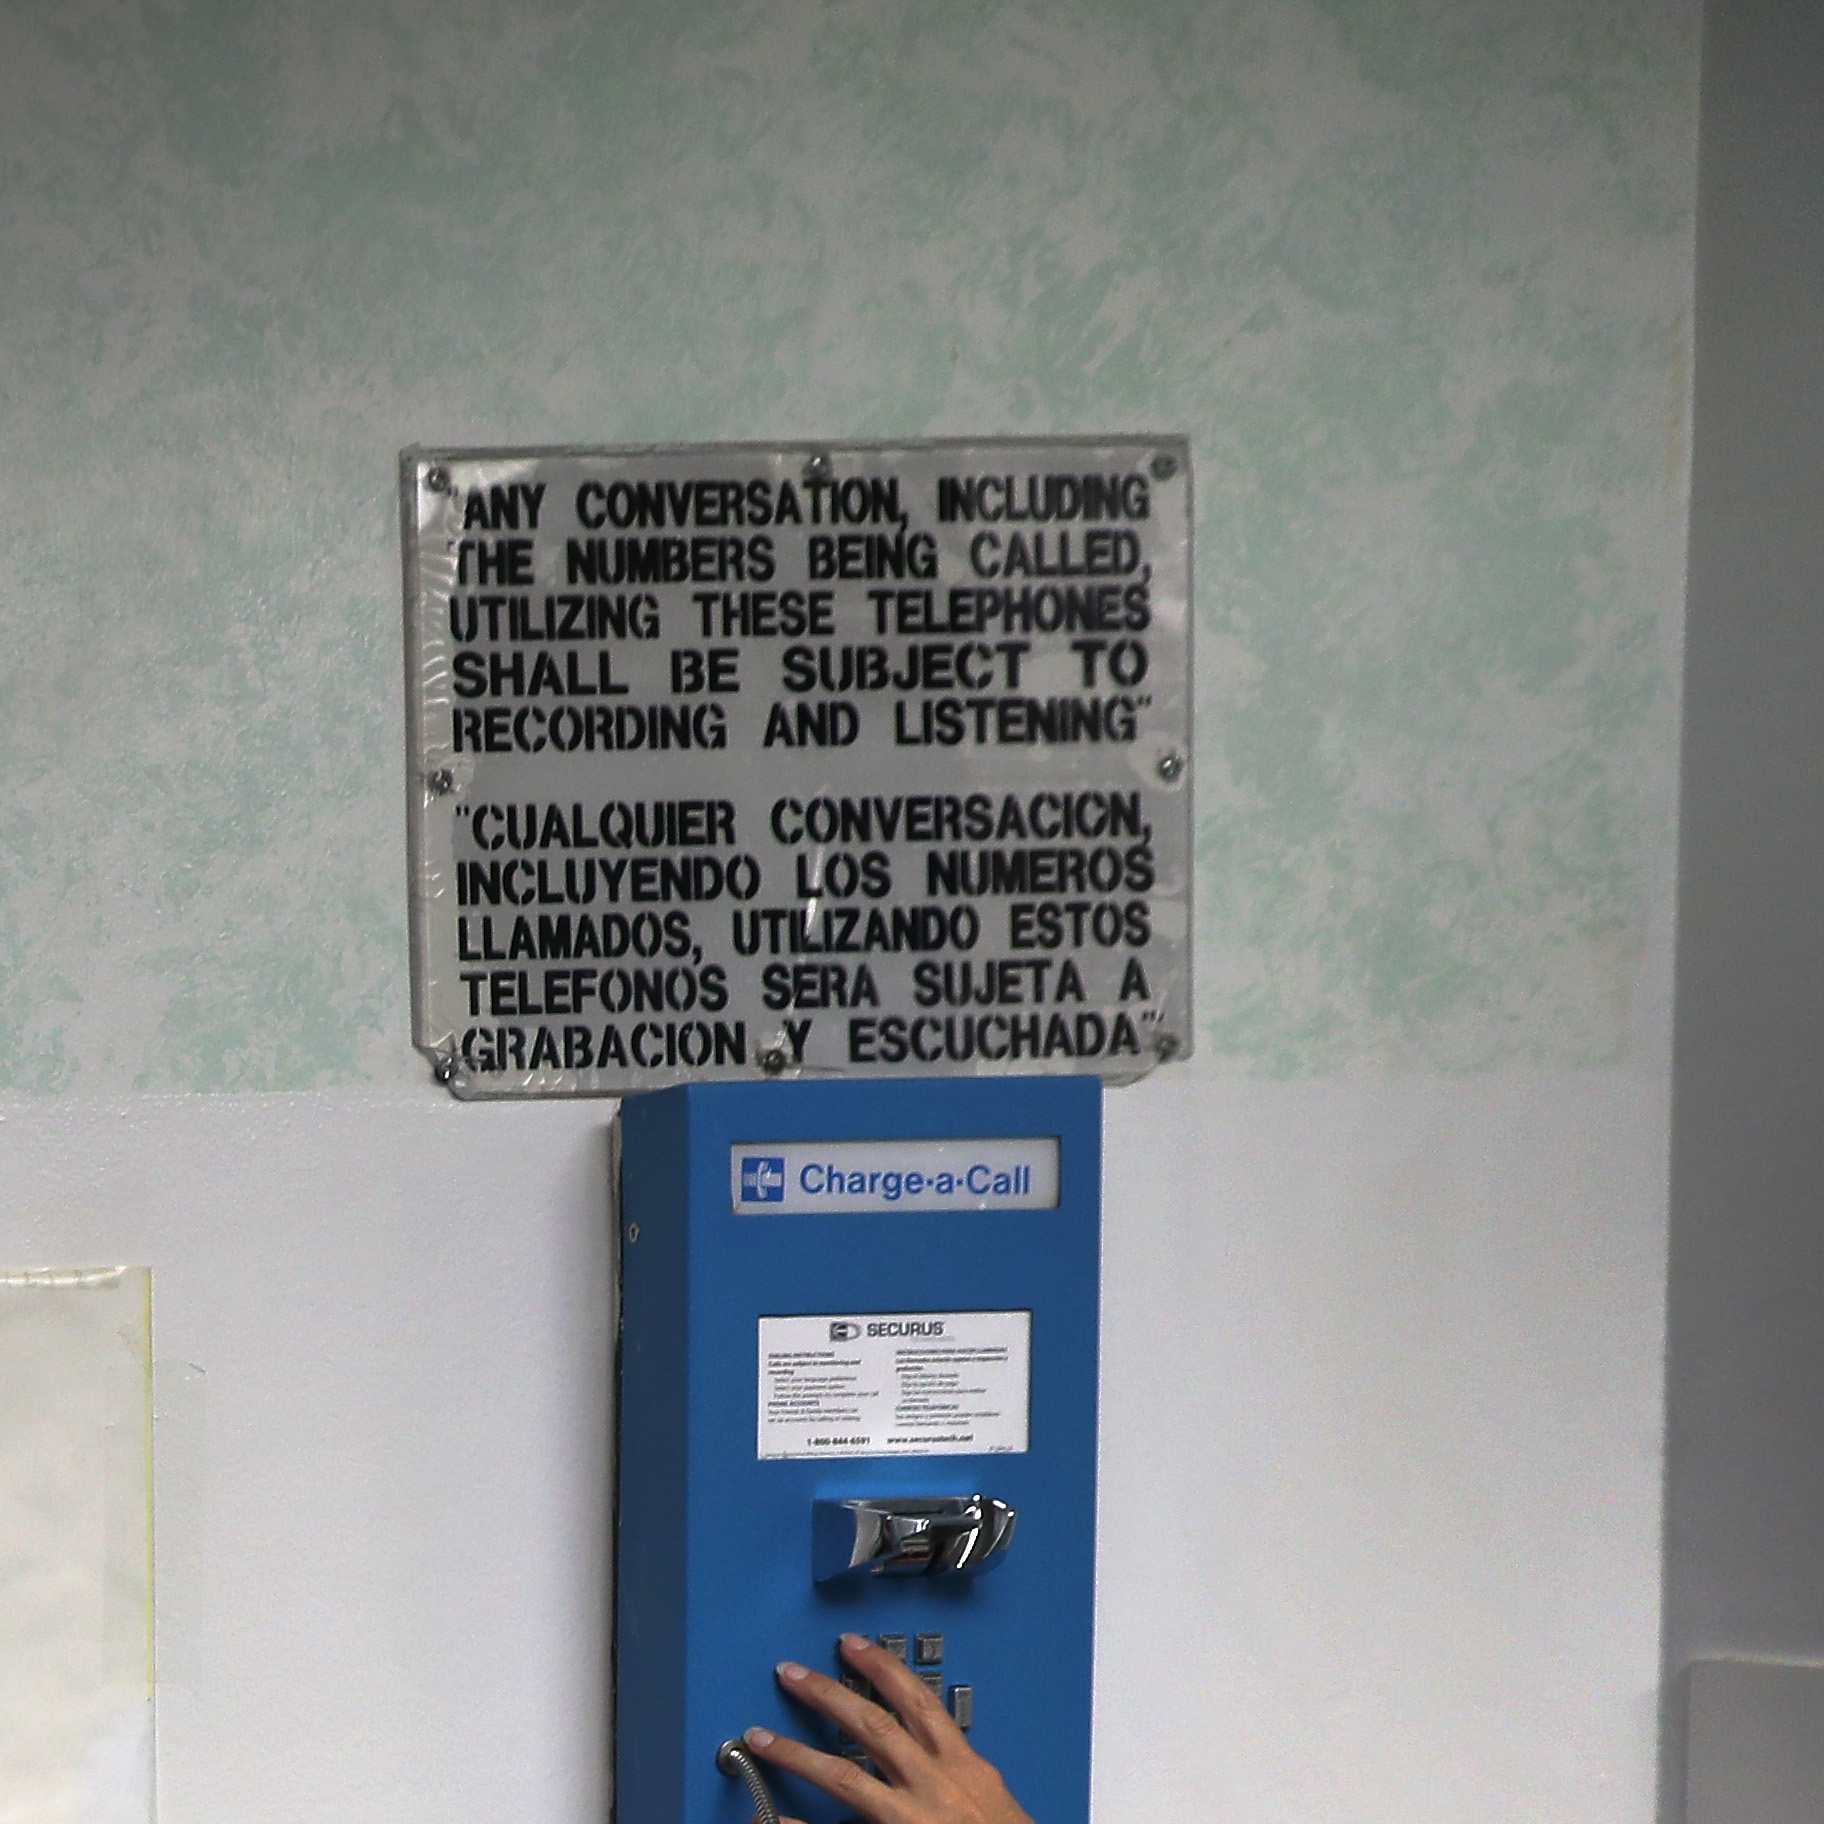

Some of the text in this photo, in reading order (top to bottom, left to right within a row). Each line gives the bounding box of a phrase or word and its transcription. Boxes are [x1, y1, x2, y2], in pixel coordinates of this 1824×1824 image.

[456, 792, 1152, 851] "CUALQUIER CONVERSACION,
[457, 844, 1154, 906] INCLUYENDO LOS NUMEROS
[458, 899, 1151, 966] LLAMADOS, UTILIZANDO ESTOS
[460, 956, 1151, 1017] TELEFONOS SERA SUJETA A
[460, 1011, 1166, 1072] GRABACION Y ESCUCHADA"
[867, 1321, 944, 1337] SECURUS
